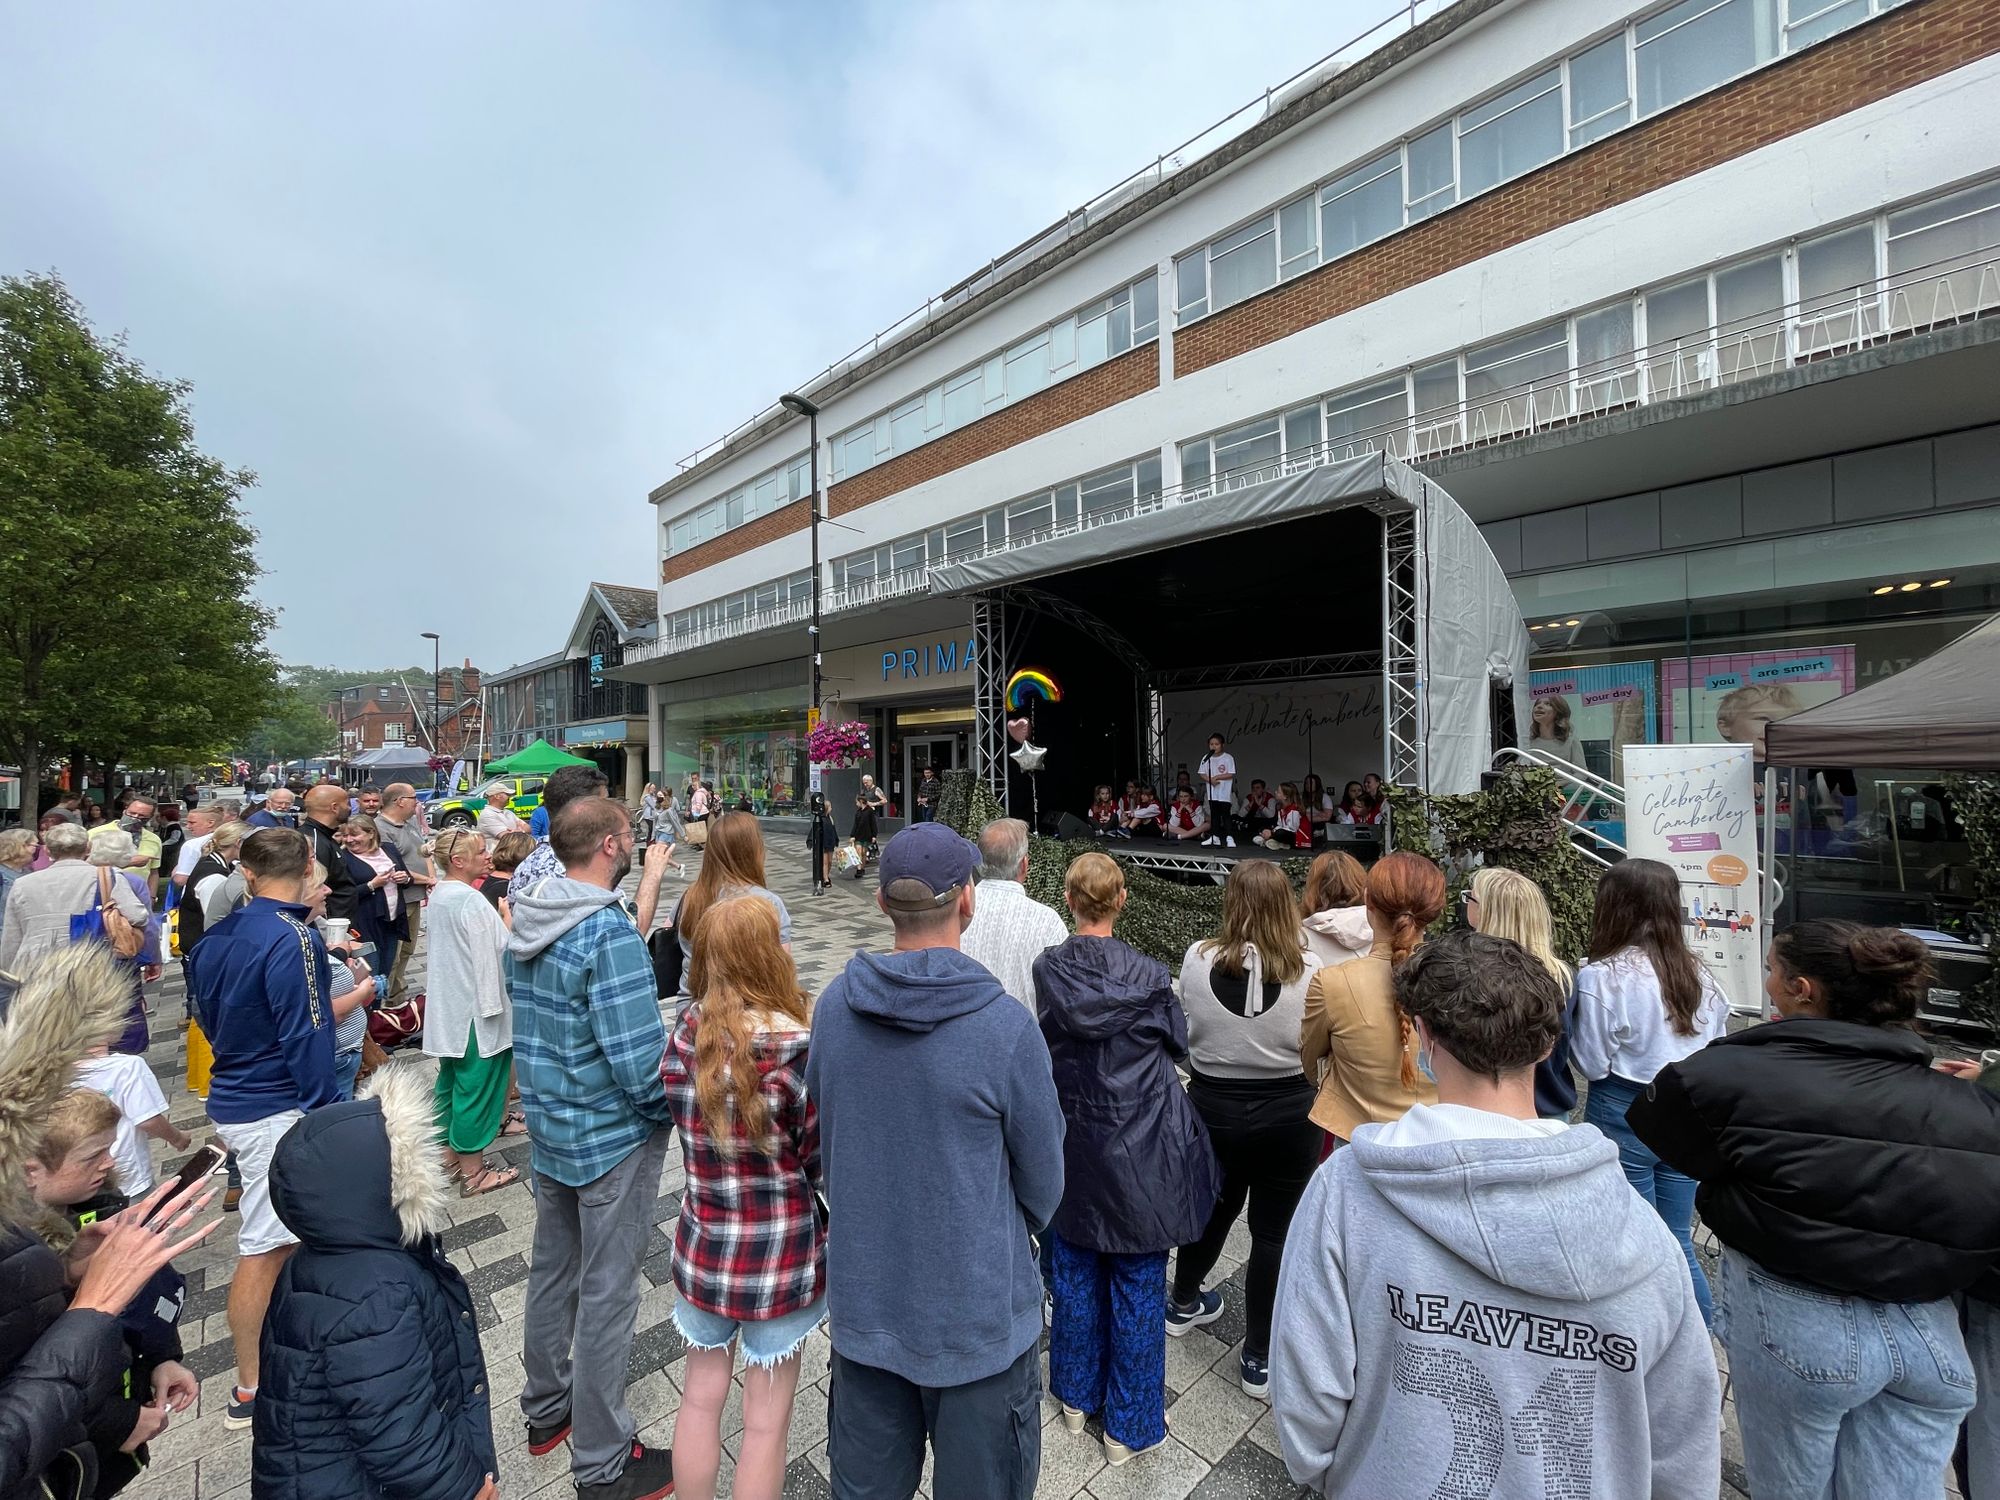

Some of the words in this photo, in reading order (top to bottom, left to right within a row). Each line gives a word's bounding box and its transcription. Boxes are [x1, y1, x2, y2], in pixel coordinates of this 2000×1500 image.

[1712, 678, 1735, 688] you
[1758, 670, 1780, 678] are
[1783, 661, 1824, 674] smart
[1533, 685, 1561, 696] today
[1586, 692, 1609, 704] your
[1612, 690, 1632, 698] day
[1227, 699, 1300, 744] Celebrate
[1642, 779, 1723, 816] Celebrate
[1654, 796, 1750, 838] Camberley
[1386, 1283, 1638, 1373] LEAVERS
